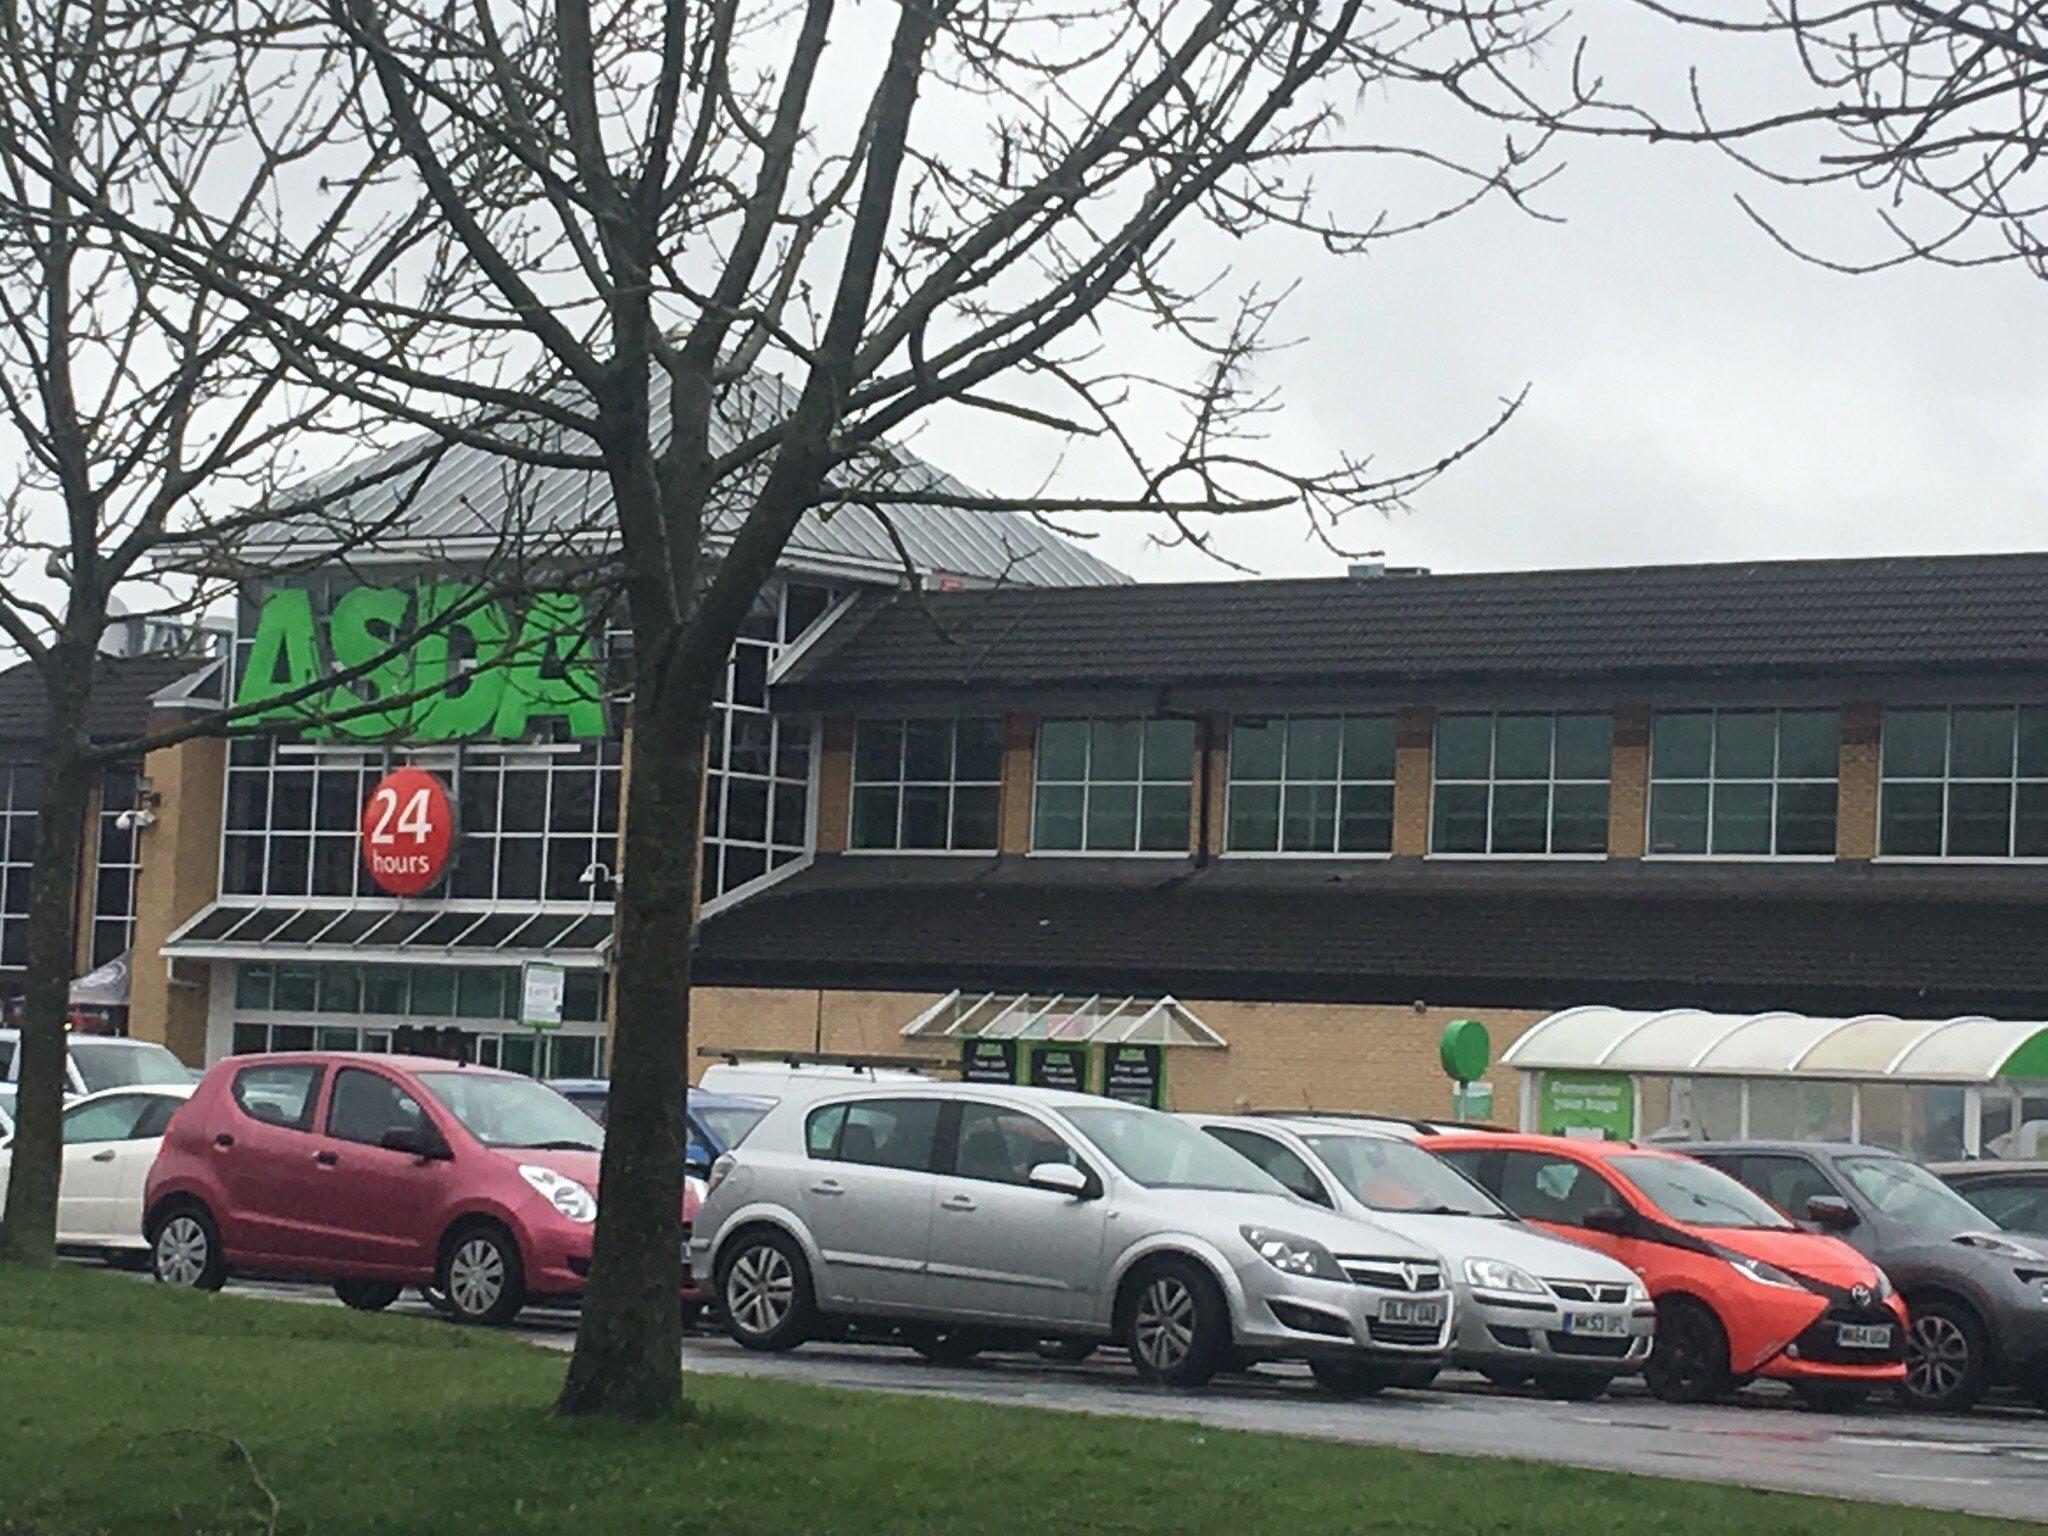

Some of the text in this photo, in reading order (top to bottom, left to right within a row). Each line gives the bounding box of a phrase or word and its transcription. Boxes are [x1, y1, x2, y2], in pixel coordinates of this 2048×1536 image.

[228, 584, 605, 739] ASDA
[371, 788, 432, 844] 24
[372, 849, 430, 874] hours
